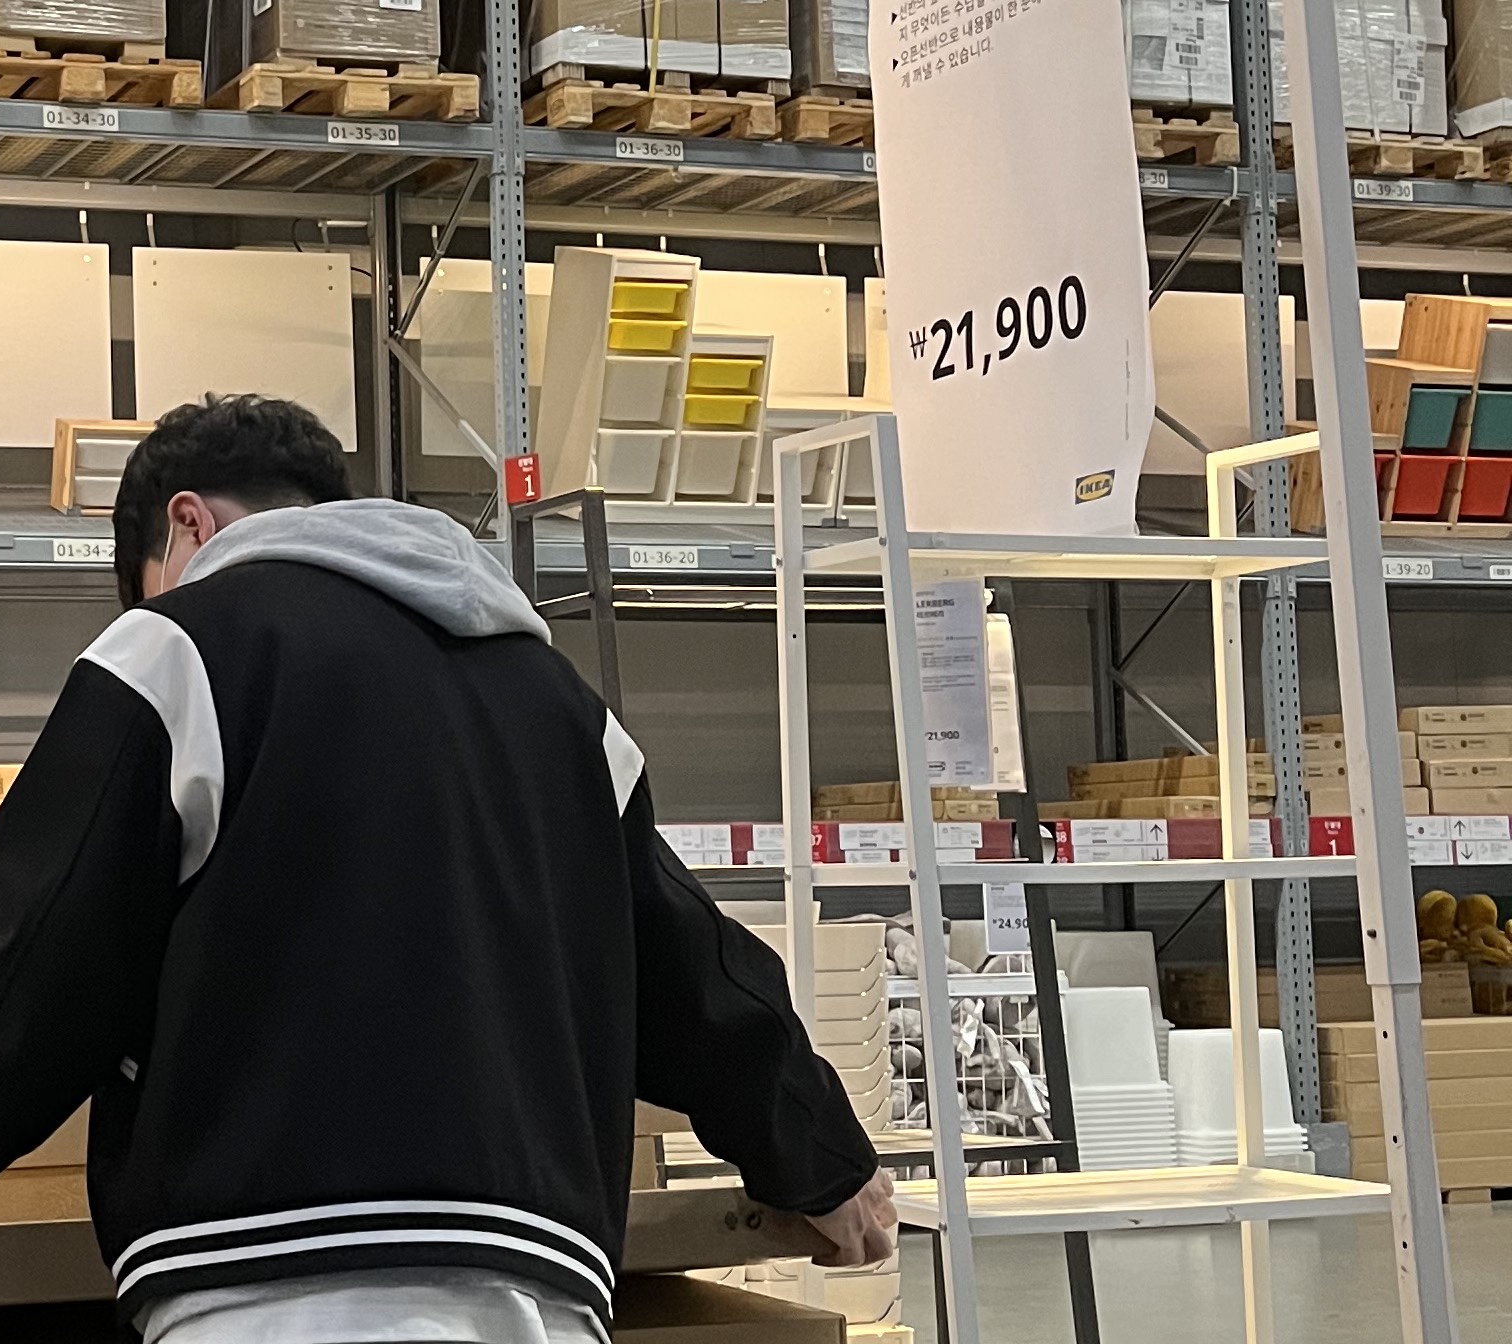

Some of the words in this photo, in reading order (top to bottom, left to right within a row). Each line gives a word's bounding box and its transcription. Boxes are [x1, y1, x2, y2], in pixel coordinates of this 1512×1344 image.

[911, 5, 950, 37] 무엇이든
[901, 27, 960, 66] 오픈선반으로
[963, 4, 1004, 36] 내용물이
[1008, 0, 1017, 18] 한
[935, 57, 945, 74] 수
[46, 111, 116, 128] 01-34-30
[330, 124, 396, 142] 01-35-30
[618, 141, 680, 157] 01-36-30
[1356, 183, 1410, 198] 01-39-30
[909, 275, 1086, 381] ₩21,900
[524, 474, 535, 497] 1
[1079, 478, 1111, 496] IKEA
[57, 543, 115, 557] 01-34-2
[633, 549, 696, 565] 01-36-20
[1386, 563, 1430, 575] 1-39-20
[1328, 838, 1338, 856] 1
